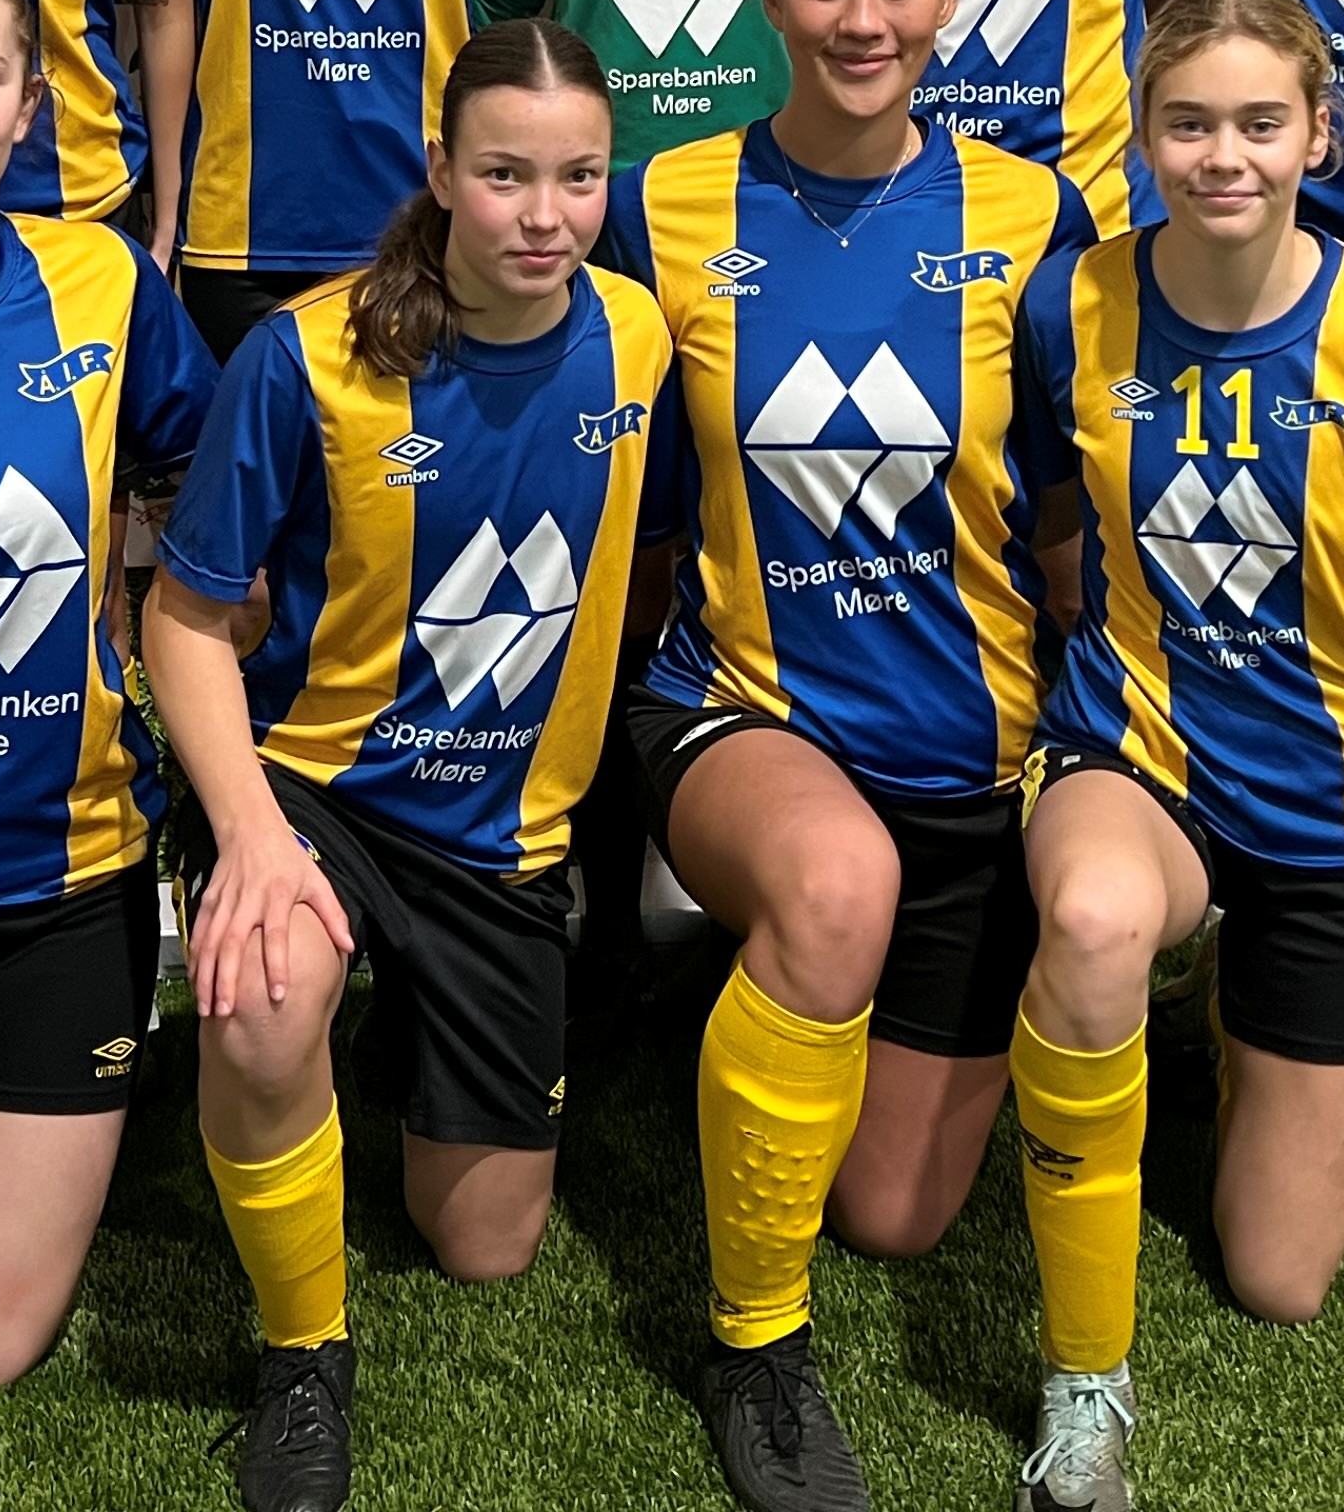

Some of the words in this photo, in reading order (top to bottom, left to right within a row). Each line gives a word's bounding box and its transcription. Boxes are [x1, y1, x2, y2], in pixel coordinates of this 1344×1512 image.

[255, 23, 420, 53] Sparebanken
[307, 58, 371, 82] Møre
[607, 64, 756, 94] Sparebanken
[652, 94, 712, 115] Møre
[909, 78, 1061, 110] parebanken
[709, 281, 761, 296] umbro
[1112, 406, 1155, 421] umbro
[1170, 365, 1260, 460] 11
[387, 469, 440, 486] umbro
[767, 547, 948, 593] Sparebanken
[834, 587, 911, 620] Møre
[1166, 610, 1304, 647] Sarebanken
[410, 757, 487, 783] Møre
